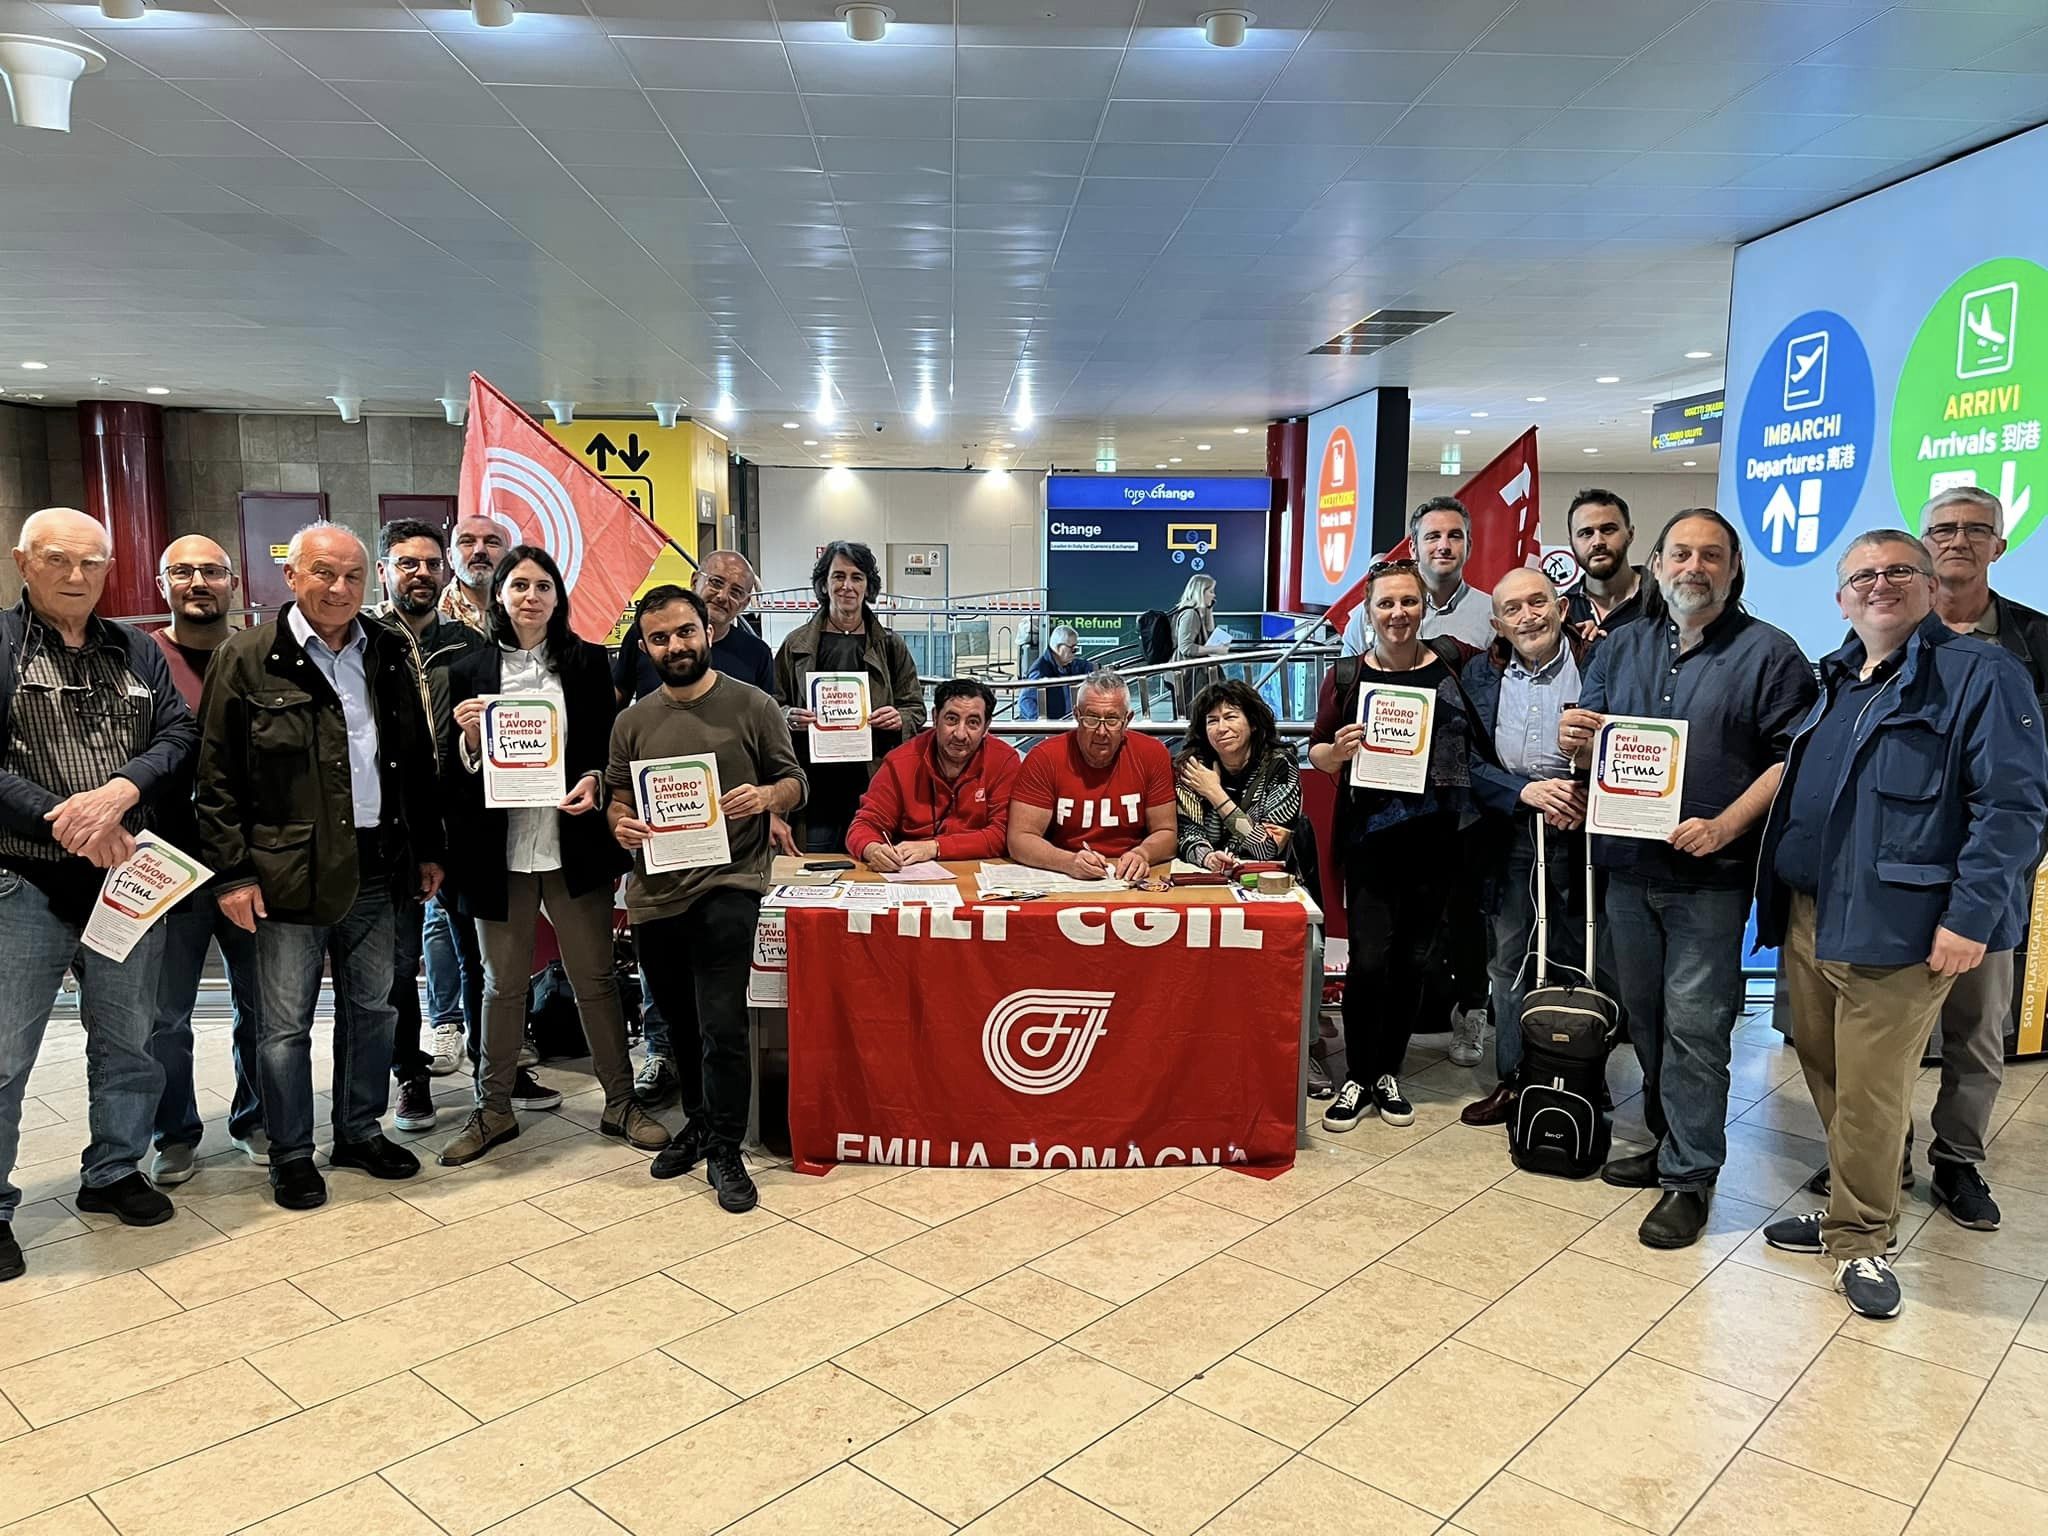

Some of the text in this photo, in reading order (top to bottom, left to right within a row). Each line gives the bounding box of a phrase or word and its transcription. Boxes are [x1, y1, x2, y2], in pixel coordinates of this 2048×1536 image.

[1944, 384, 2020, 421] ARRIVI
[1763, 413, 1841, 448] IMBARCHI
[1917, 419, 2041, 461] Arrivals 到港
[1746, 452, 1825, 482] Departures
[1051, 523, 1102, 537] Change
[1050, 617, 1122, 629] Tax Refund
[822, 705, 858, 722] firma
[1373, 722, 1416, 742] firma
[1616, 734, 1630, 742] Per
[500, 736, 547, 758] firma
[1623, 753, 1650, 761] metto
[1612, 759, 1664, 783] firma
[663, 791, 689, 799] metto
[656, 800, 704, 822] firma
[1056, 793, 1141, 828] FILT
[141, 853, 155, 863] Per
[112, 871, 157, 900] firma
[133, 869, 156, 886] metto
[156, 881, 164, 890] la
[1056, 906, 1263, 950] CGIL
[2024, 879, 2047, 1028] SOLO PLASTICA/LATTINE
[837, 1132, 990, 1168] EMILIA
